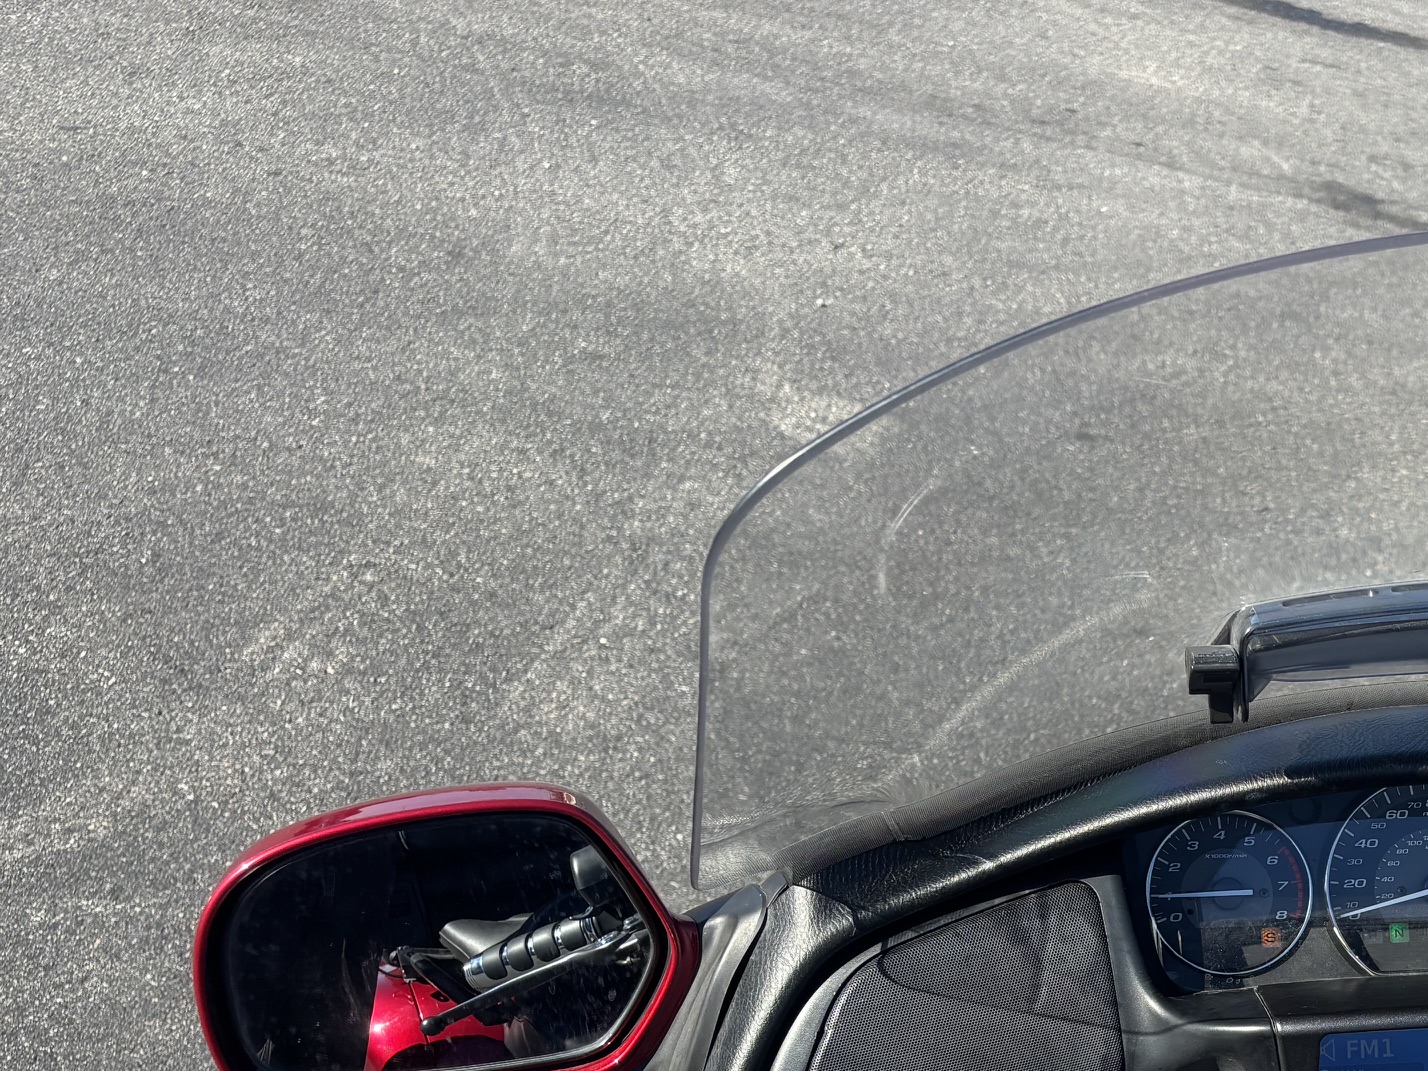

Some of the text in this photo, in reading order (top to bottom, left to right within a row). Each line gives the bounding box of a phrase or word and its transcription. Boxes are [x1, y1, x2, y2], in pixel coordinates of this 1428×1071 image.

[1386, 810, 1408, 819] 60
[1213, 831, 1226, 839] 4
[1244, 837, 1255, 845] 5
[1355, 839, 1378, 847] 40
[1187, 841, 1199, 850] 3
[1266, 856, 1279, 864] 6
[1169, 863, 1180, 871] 2
[1278, 882, 1288, 890] 7
[1344, 879, 1366, 888] 20
[1170, 913, 1183, 921] 0
[1275, 911, 1287, 919] 8
[1346, 1039, 1394, 1059] FM1
